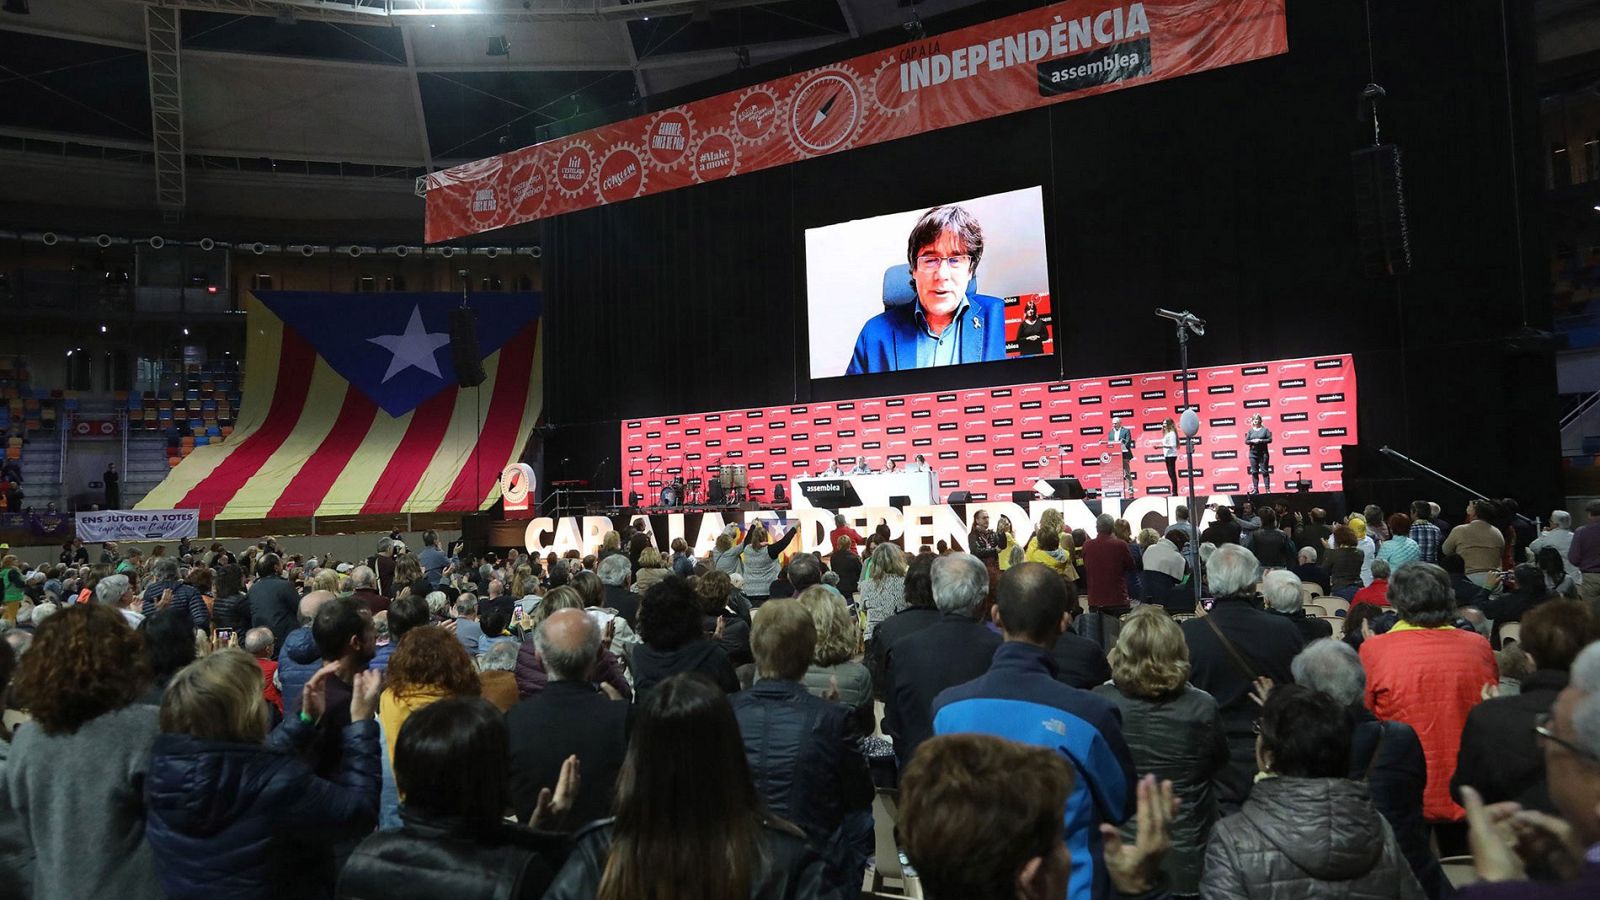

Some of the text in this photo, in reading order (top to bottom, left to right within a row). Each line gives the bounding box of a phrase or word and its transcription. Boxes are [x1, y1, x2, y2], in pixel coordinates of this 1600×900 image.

[900, 2, 1151, 93] INDEPENDÈNCIA
[900, 41, 941, 61] CAP A LA
[1051, 52, 1140, 83] assemblea
[699, 148, 730, 163] #Make
[706, 157, 730, 170] move
[806, 483, 841, 492] assemblea
[82, 513, 194, 524] ENS JUTGEN A TOTES
[525, 515, 614, 559] CAP
